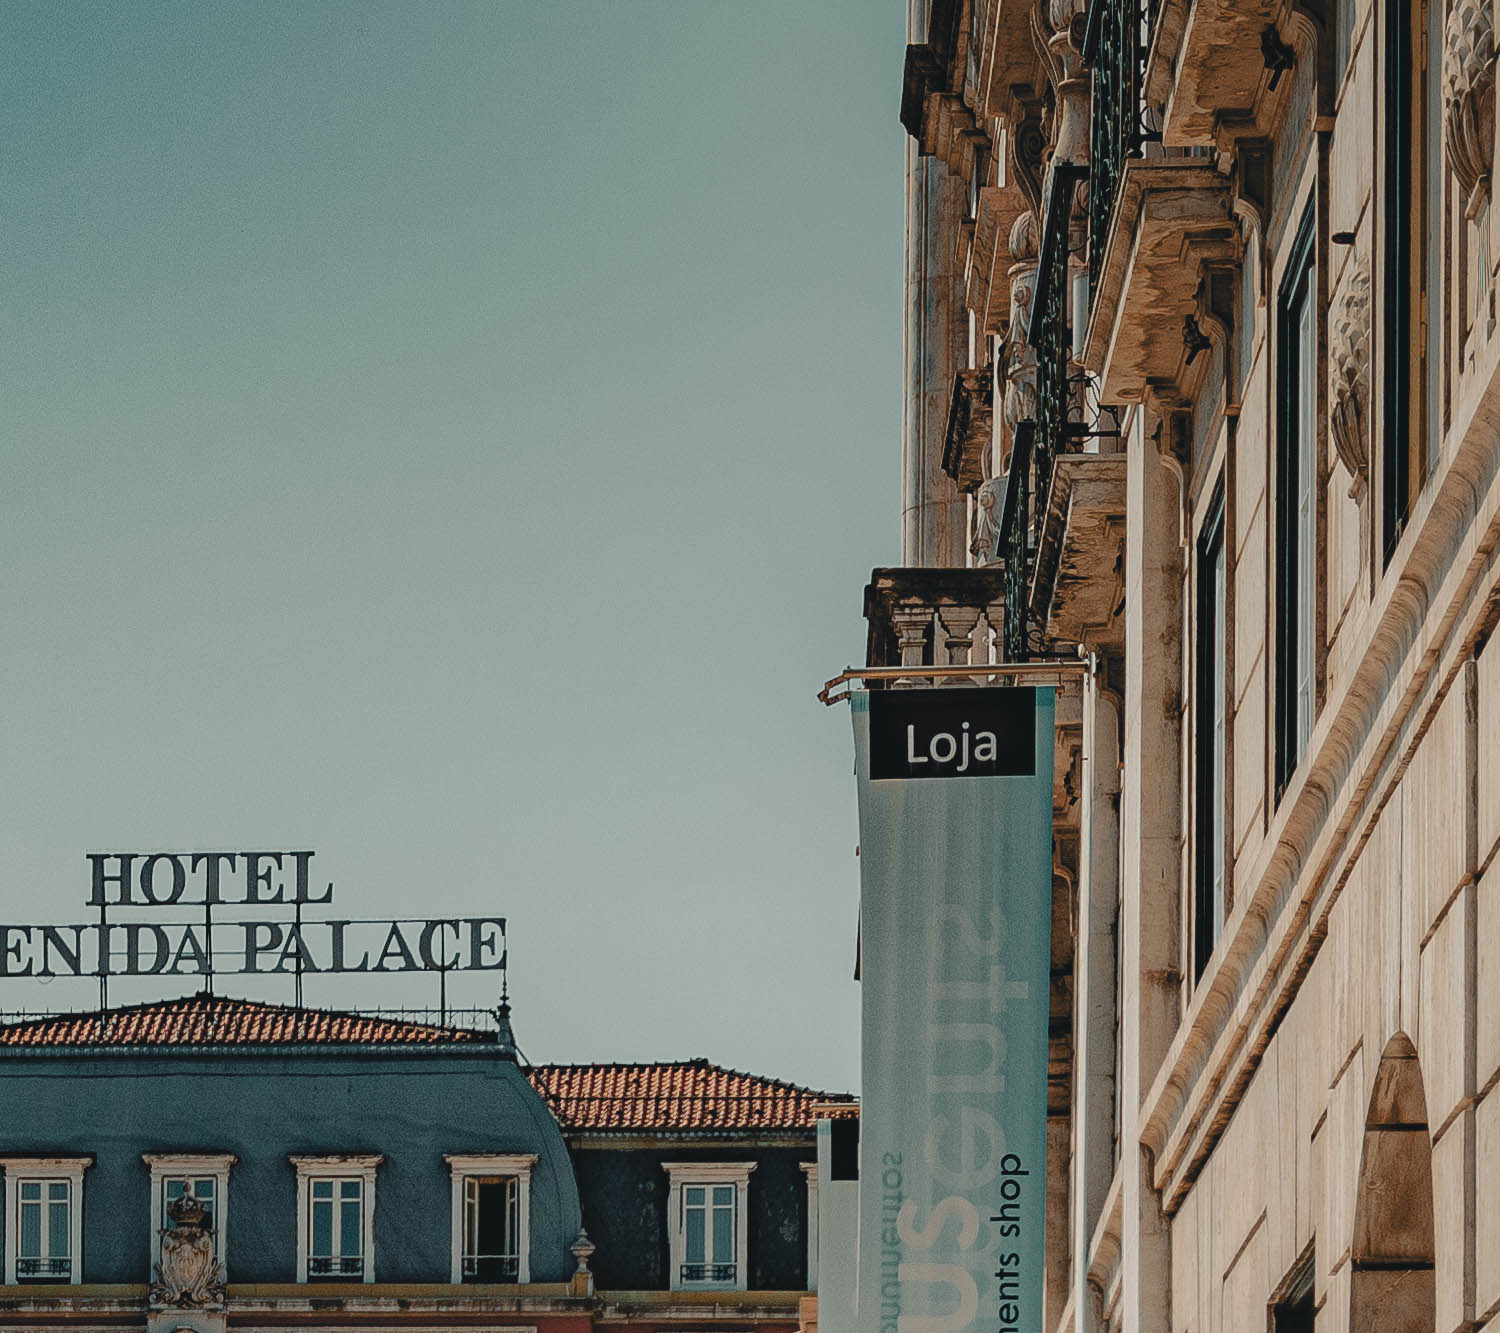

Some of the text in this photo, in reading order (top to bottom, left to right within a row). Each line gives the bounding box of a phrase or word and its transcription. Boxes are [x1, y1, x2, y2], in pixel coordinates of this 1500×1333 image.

[906, 721, 998, 772] Loja
[85, 850, 333, 906] HOTEL
[239, 917, 507, 974] PALACE
[989, 1152, 1031, 1239] shop
